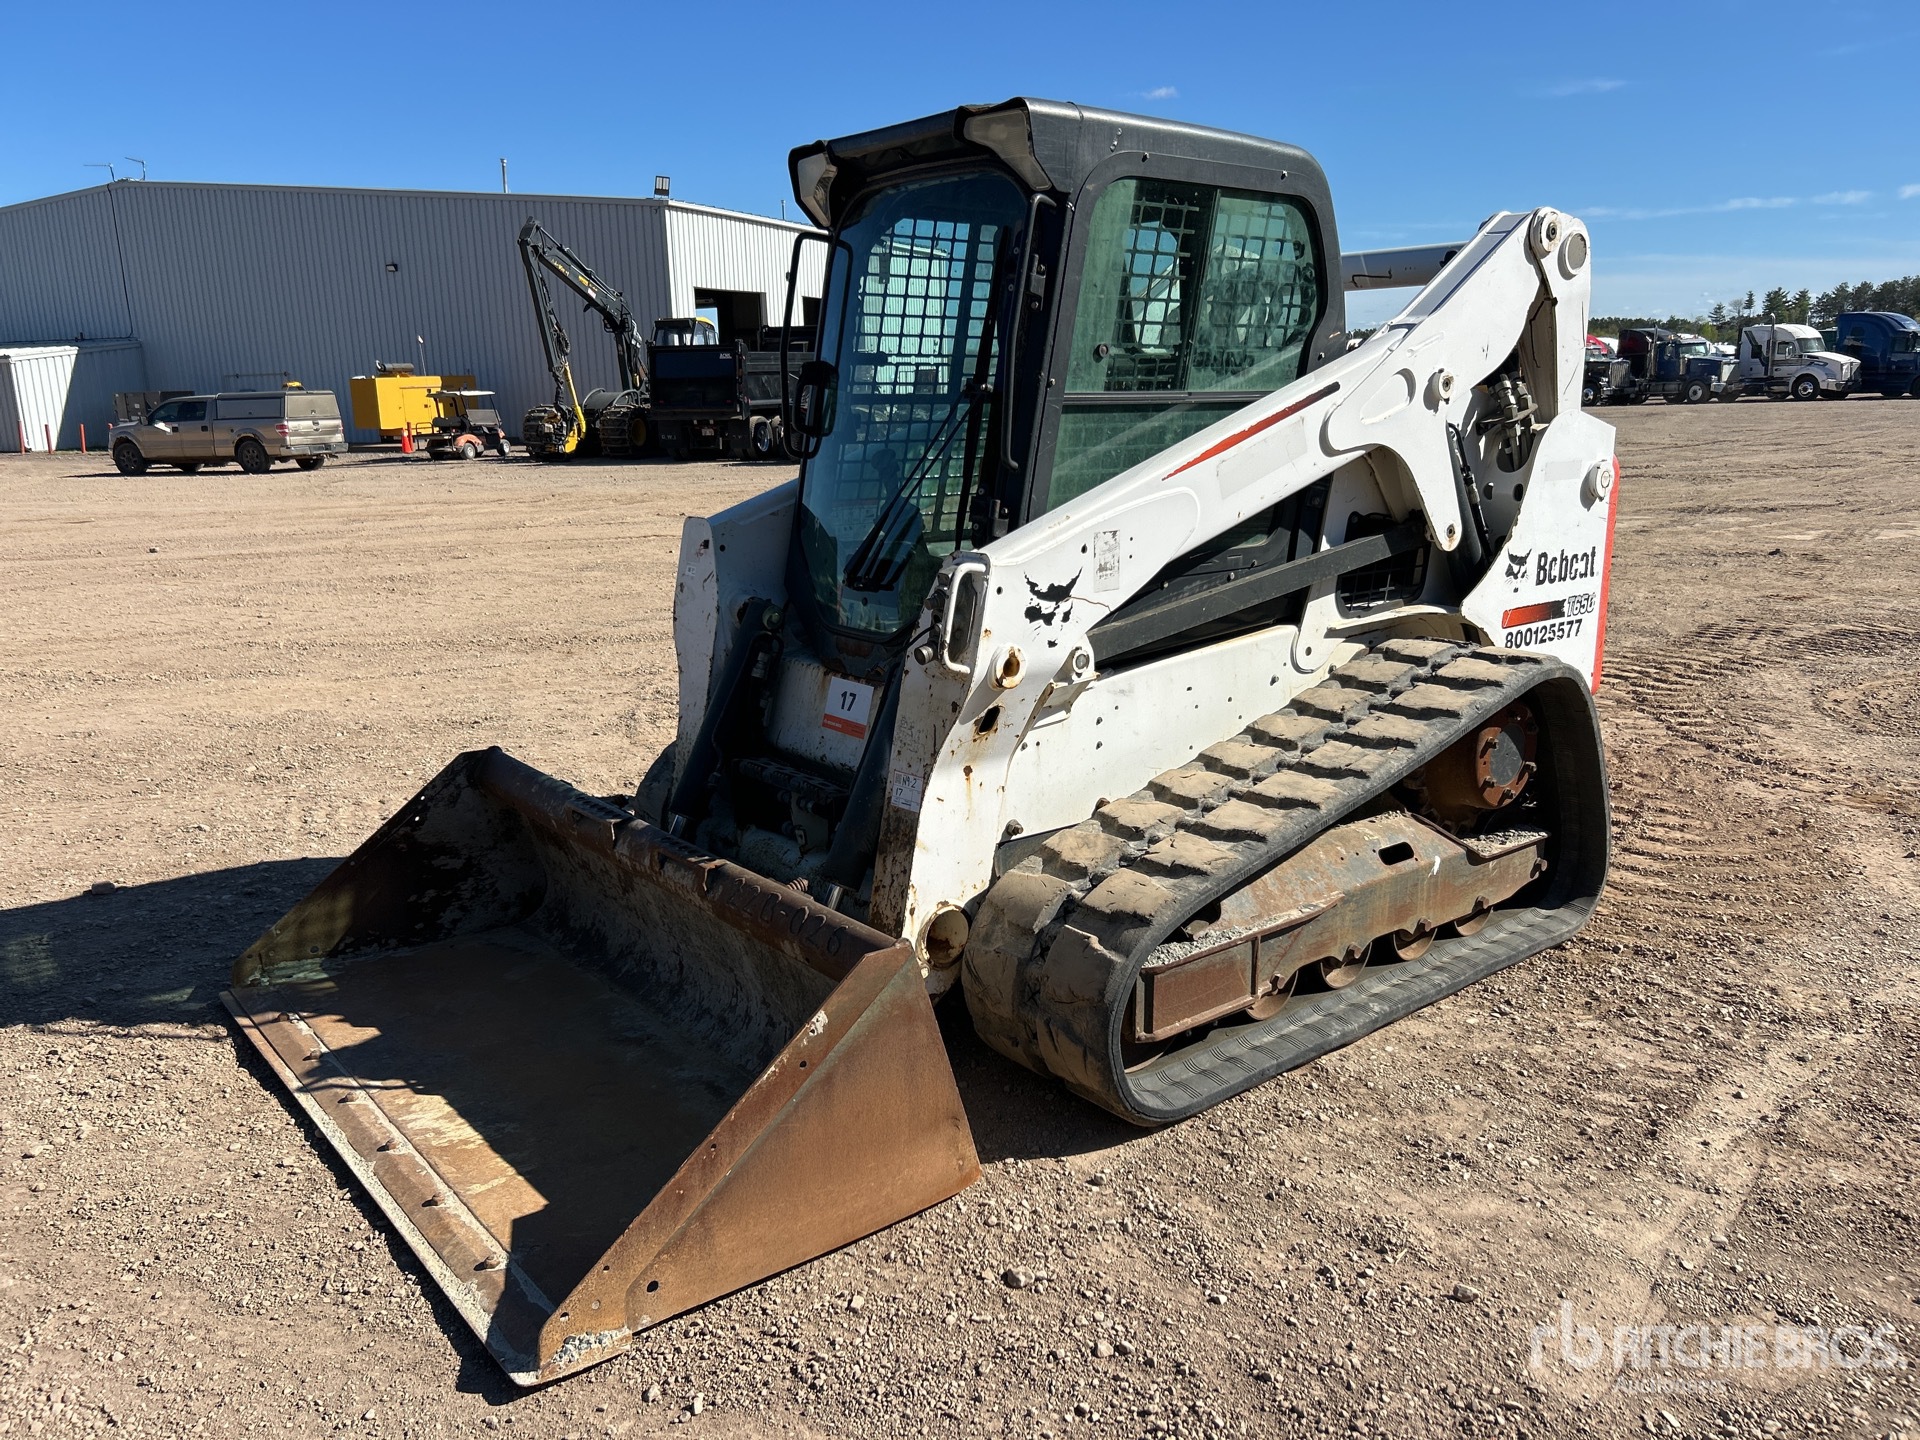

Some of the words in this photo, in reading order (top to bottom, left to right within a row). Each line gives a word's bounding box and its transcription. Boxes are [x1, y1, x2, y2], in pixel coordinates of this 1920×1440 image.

[1535, 546, 1596, 586] Bobcat
[1567, 592, 1596, 617] T650
[1505, 619, 1582, 649] 800125577
[840, 691, 857, 712] 17
[895, 787, 904, 796] 17
